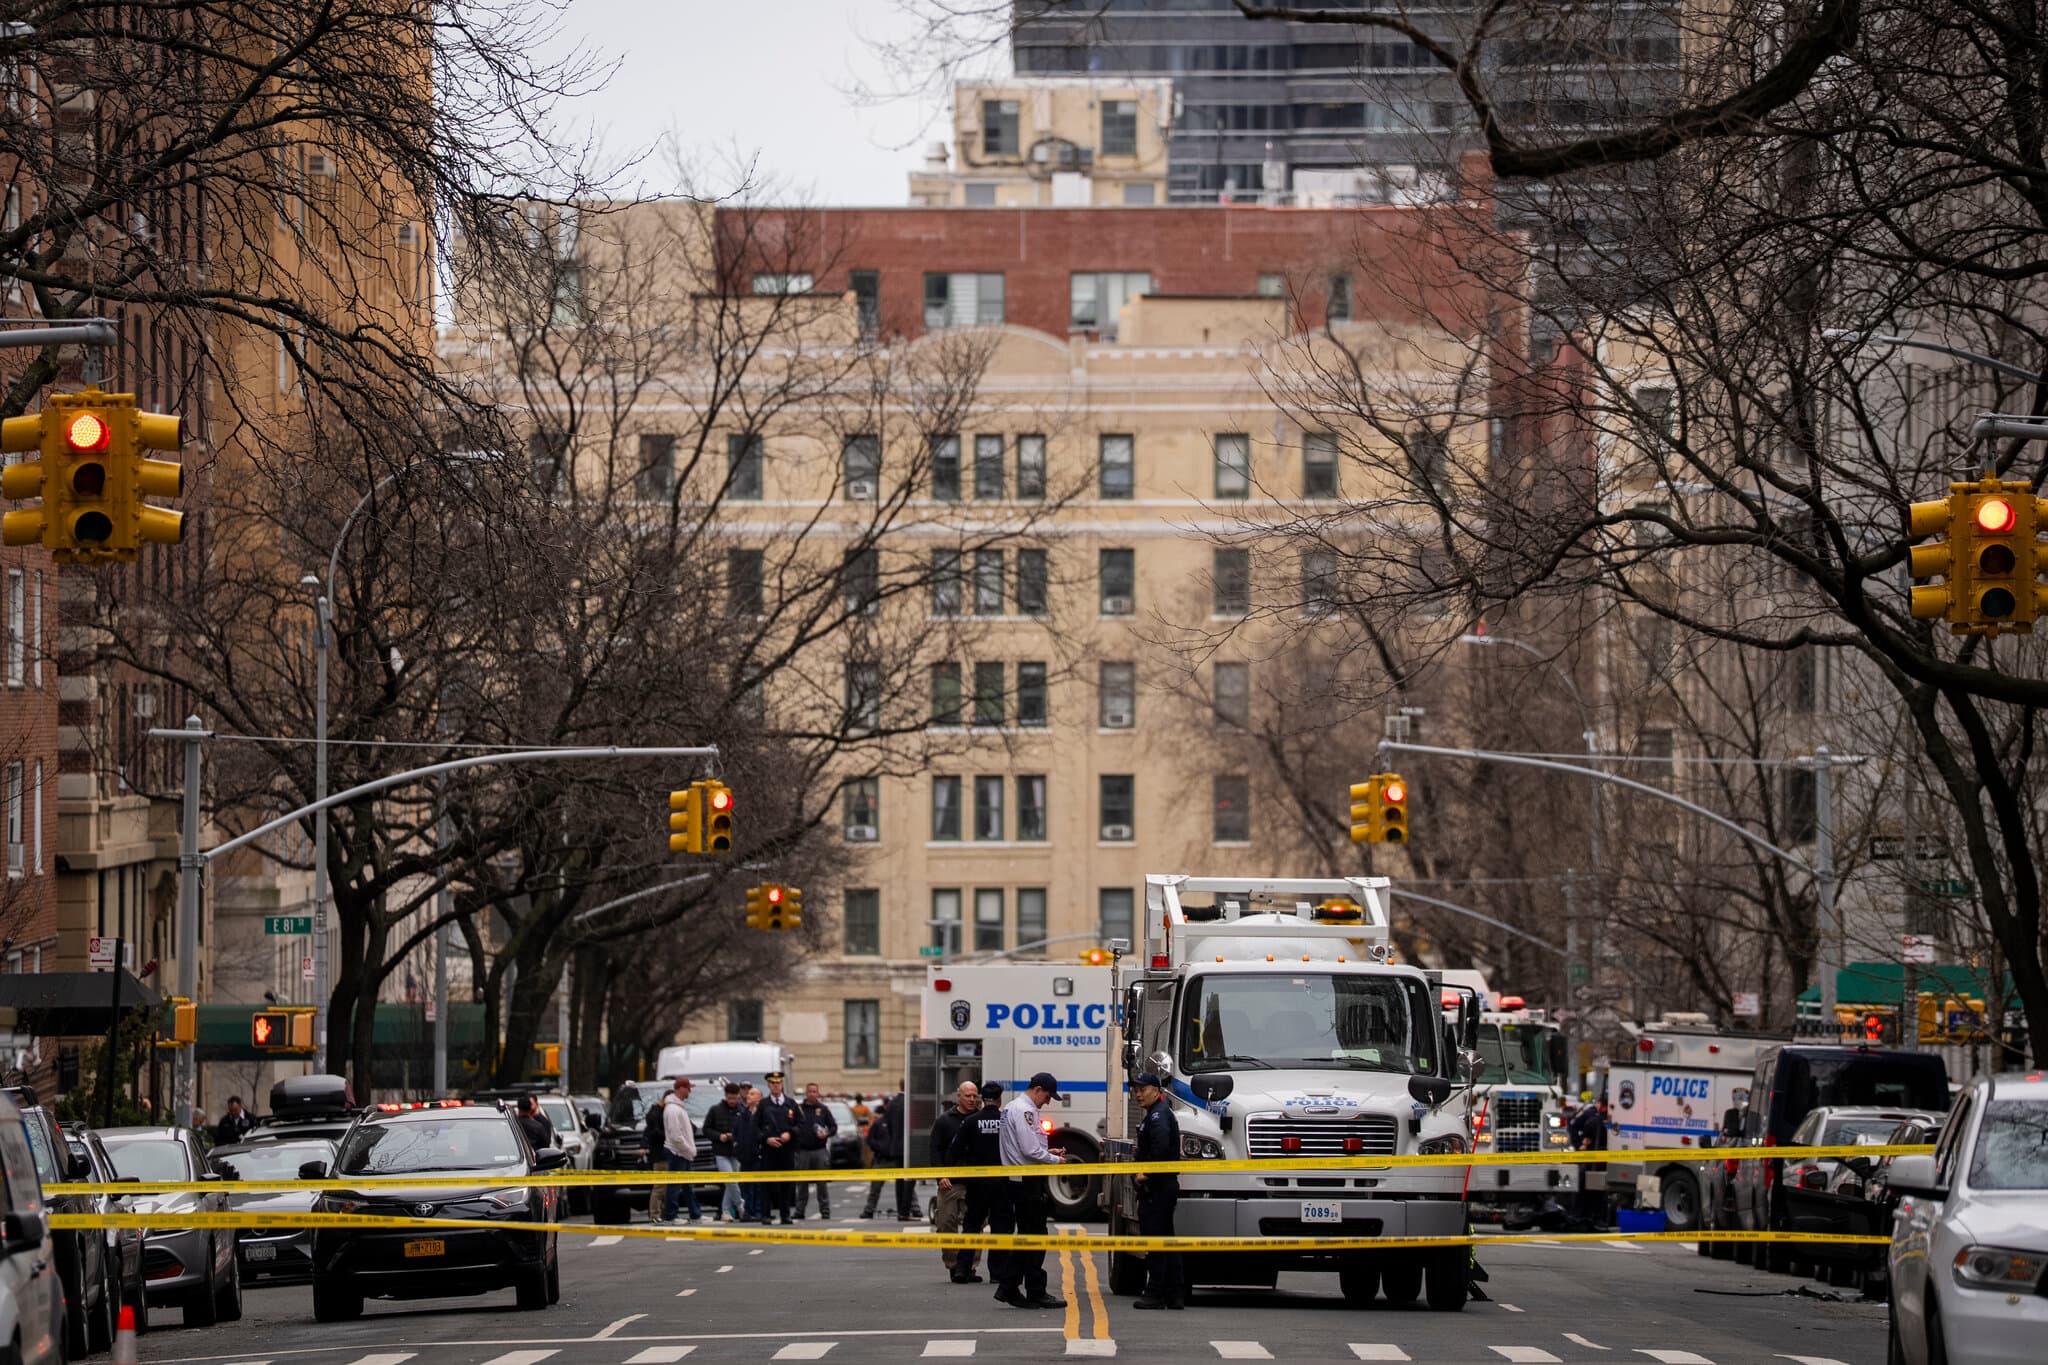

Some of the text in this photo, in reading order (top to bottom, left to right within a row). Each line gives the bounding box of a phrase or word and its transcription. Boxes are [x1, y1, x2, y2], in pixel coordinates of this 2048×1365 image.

[273, 919, 279, 932] E
[283, 919, 294, 932] 81
[1032, 1035, 1101, 1046] BOMB SQUAD
[1651, 1076, 1709, 1098] POLICE
[978, 1120, 1001, 1128] NYPD
[1304, 1207, 1330, 1218] 7089
